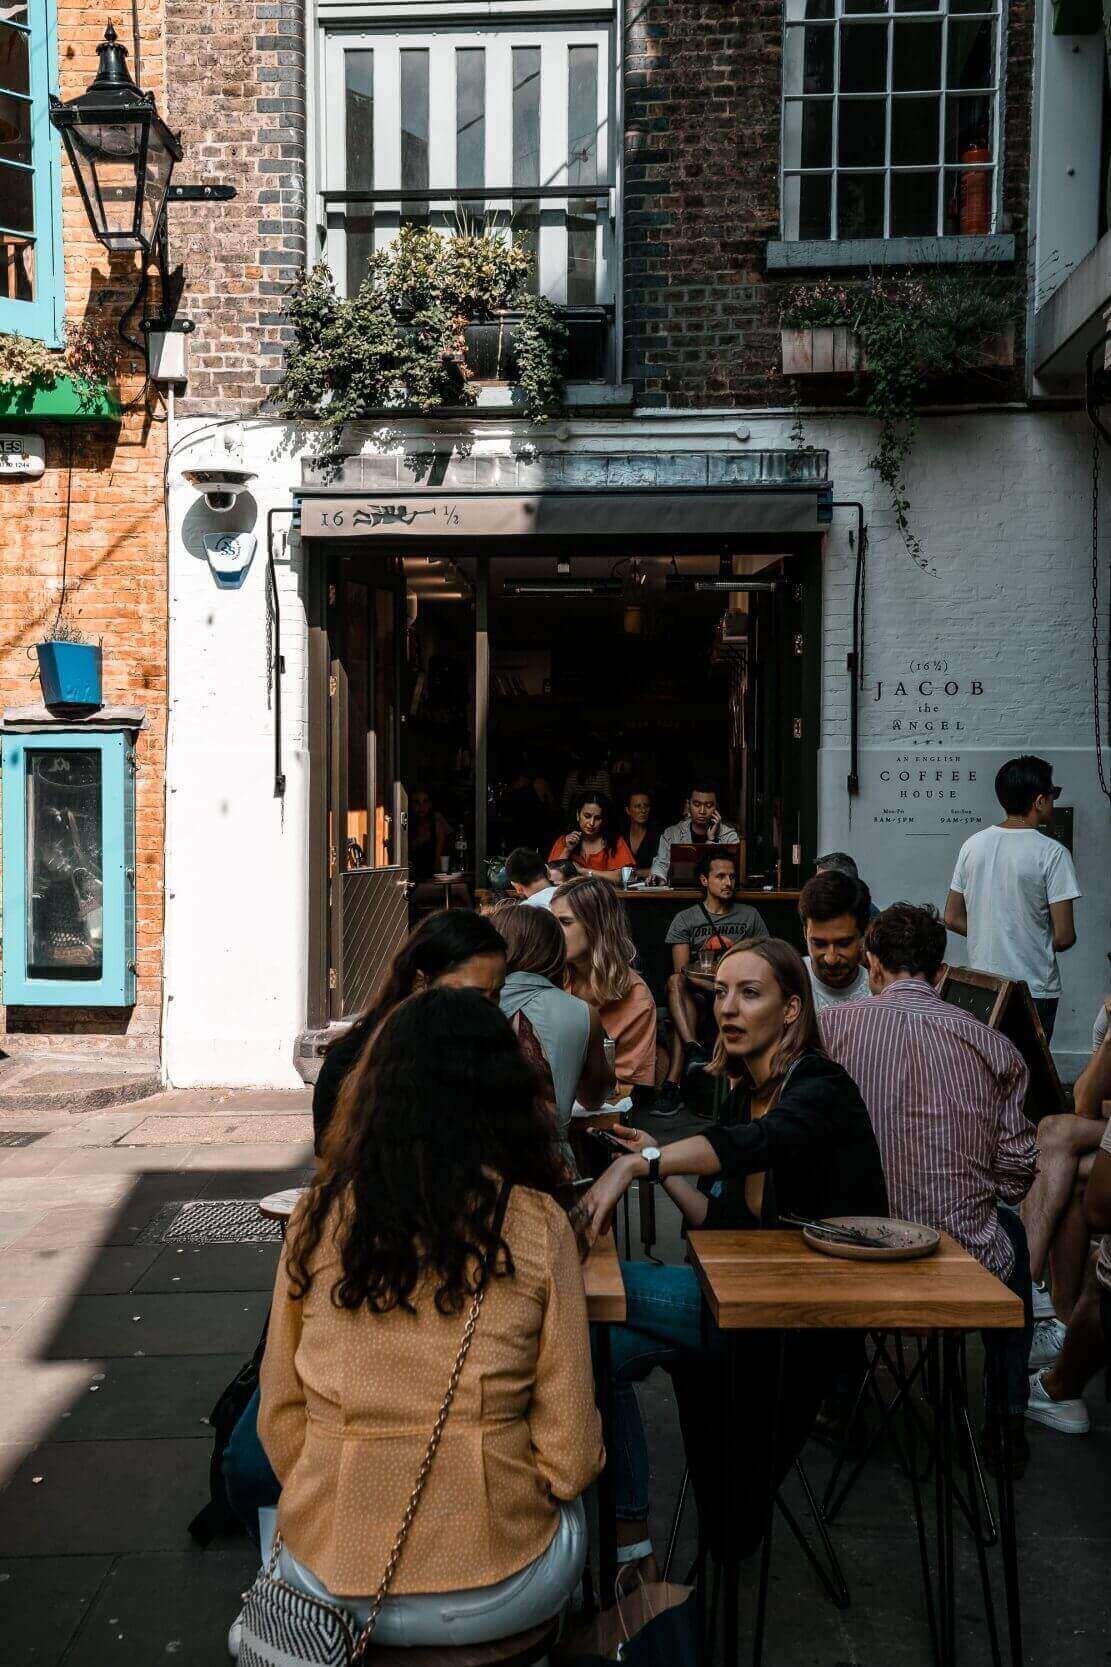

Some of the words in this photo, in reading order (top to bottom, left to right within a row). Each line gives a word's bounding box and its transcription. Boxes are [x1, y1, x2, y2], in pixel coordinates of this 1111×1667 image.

[320, 511, 344, 526] 16
[874, 681, 984, 701] JACOB
[918, 703, 940, 713] the
[892, 719, 965, 731] ANGEL
[880, 771, 977, 782] COFFEE
[900, 790, 957, 799] HOUSE
[694, 925, 746, 938] ORIINALS
